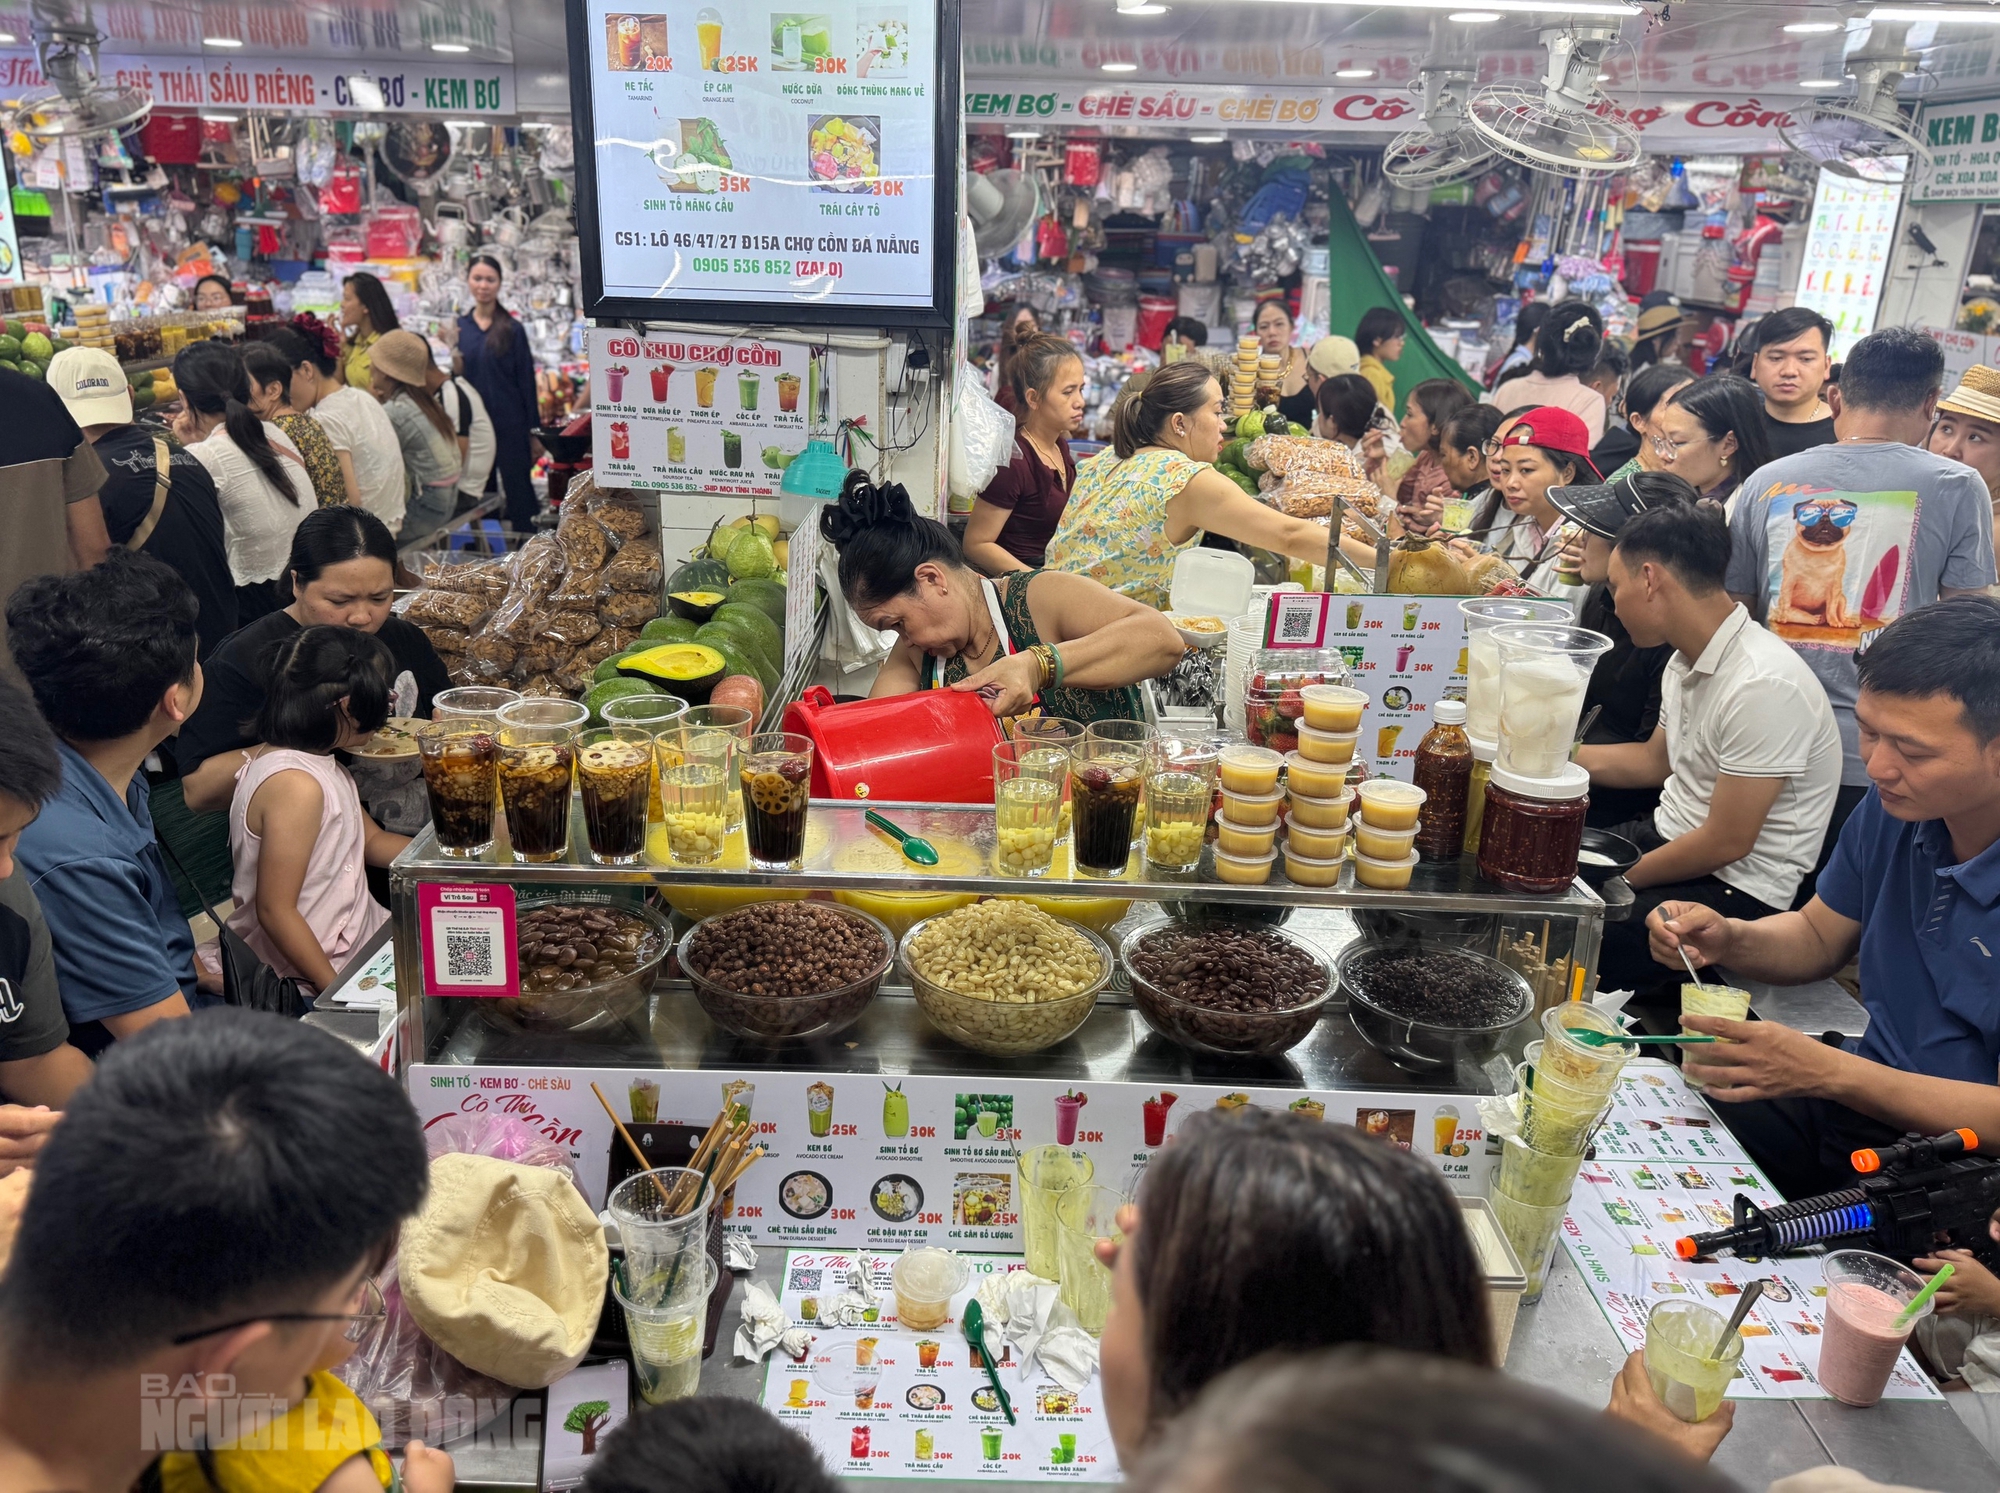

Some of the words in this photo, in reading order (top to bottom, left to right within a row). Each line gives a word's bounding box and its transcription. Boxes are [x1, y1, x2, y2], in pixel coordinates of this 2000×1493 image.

[645, 56, 673, 72] 20K
[726, 55, 758, 72] 25K
[814, 57, 847, 74] 30K
[159, 66, 204, 103] THÁI
[210, 61, 250, 104] SẦU
[254, 67, 314, 105] RIÊNG
[704, 80, 714, 92] ÉP
[717, 83, 732, 92] CAM
[782, 82, 804, 94] NƯỚC
[806, 82, 822, 95] DỪA
[424, 78, 468, 109] KEM
[474, 76, 500, 110] BƠ
[837, 84, 858, 96] ĐÓNG
[861, 84, 888, 96] THÙNG
[890, 87, 912, 96] MANG
[965, 93, 1012, 114] KEM
[1016, 92, 1059, 116] BƠ
[1078, 91, 1134, 117] CHÈ
[1138, 89, 1197, 120] SẦU
[1276, 98, 1322, 122] BƠ
[1333, 94, 1415, 121] Cô
[1685, 98, 1797, 128] Cồn
[1927, 115, 1976, 147] KEM
[1981, 112, 2000, 143] B
[719, 176, 750, 192] 35K
[1956, 172, 1975, 184] XOA
[1978, 171, 1998, 184] XOA
[872, 180, 904, 196] 30K
[644, 200, 666, 211] SINH
[670, 196, 682, 211] TỐ
[686, 198, 712, 212] MÃNG
[820, 202, 842, 216] TRÁI
[846, 202, 864, 216] CÂY
[868, 203, 880, 216] TÔ
[616, 232, 646, 246] CS1:
[651, 230, 668, 247] LÔ
[674, 233, 736, 250] 46/47/27
[742, 236, 780, 250] Đ15A
[784, 236, 814, 254] CHỢ
[818, 232, 848, 252] CỒN
[852, 234, 872, 253] ĐÀ
[877, 234, 919, 254] NẴNG
[693, 258, 728, 272] 0905
[734, 258, 760, 274] 536
[765, 260, 791, 275] 852
[796, 261, 843, 278] (ZALO)
[608, 337, 638, 357] CÔ
[642, 341, 684, 360] THU
[688, 344, 733, 366] CHỢ
[736, 343, 782, 366] CỒN
[76, 378, 109, 390] COLORADO
[712, 410, 720, 418] ÉP
[790, 415, 804, 423] TẮC
[111, 450, 198, 474] Thaand
[1364, 620, 1383, 628] 30K
[1421, 622, 1440, 630] 30K
[1357, 662, 1376, 670] 35K
[1414, 664, 1434, 672] 30K
[1407, 704, 1426, 712] 30K
[430, 1077, 454, 1088] SINH
[457, 1074, 470, 1088] TỐ
[480, 1078, 500, 1088] KEM
[505, 1078, 518, 1089] BƠ
[528, 1076, 548, 1090] CHÈ
[551, 1076, 570, 1090] SẦU
[461, 1094, 489, 1112] Cô
[495, 1094, 537, 1114] Thu
[832, 1124, 857, 1136] 25K
[910, 1126, 936, 1138] 30K
[996, 1128, 1022, 1140] 35K
[1078, 1131, 1103, 1142] 30K
[1456, 1129, 1482, 1140] 25K
[807, 1144, 821, 1152] KEM
[823, 1144, 832, 1152] BƠ
[898, 1144, 908, 1154] TỐ
[910, 1146, 919, 1154] BƠ
[962, 1146, 972, 1156] TỐ
[974, 1148, 983, 1156] BƠ
[1444, 1163, 1452, 1172] ÉP
[738, 1206, 762, 1217] 20K
[831, 1208, 856, 1220] 30K
[918, 1213, 943, 1224] 30K
[993, 1213, 1018, 1224] 25K
[768, 1224, 780, 1233] CHÈ
[783, 1225, 798, 1234] THÁI
[816, 1226, 837, 1234] RIÊNG
[867, 1228, 880, 1236] CHÈ
[883, 1228, 896, 1236] ĐẬU
[898, 1229, 912, 1237] HẠT
[1563, 1218, 1582, 1236] KEM
[964, 1230, 978, 1238] SÂM
[991, 1231, 1014, 1240] LƯỢNG
[1573, 1244, 1594, 1258] TỐ
[792, 1254, 814, 1267] Cô
[820, 1256, 851, 1268] Thu
[974, 1261, 993, 1273] TỐ
[1586, 1258, 1610, 1283] SINH
[1606, 1290, 1628, 1314] Cồn
[1618, 1316, 1644, 1340] Chợ
